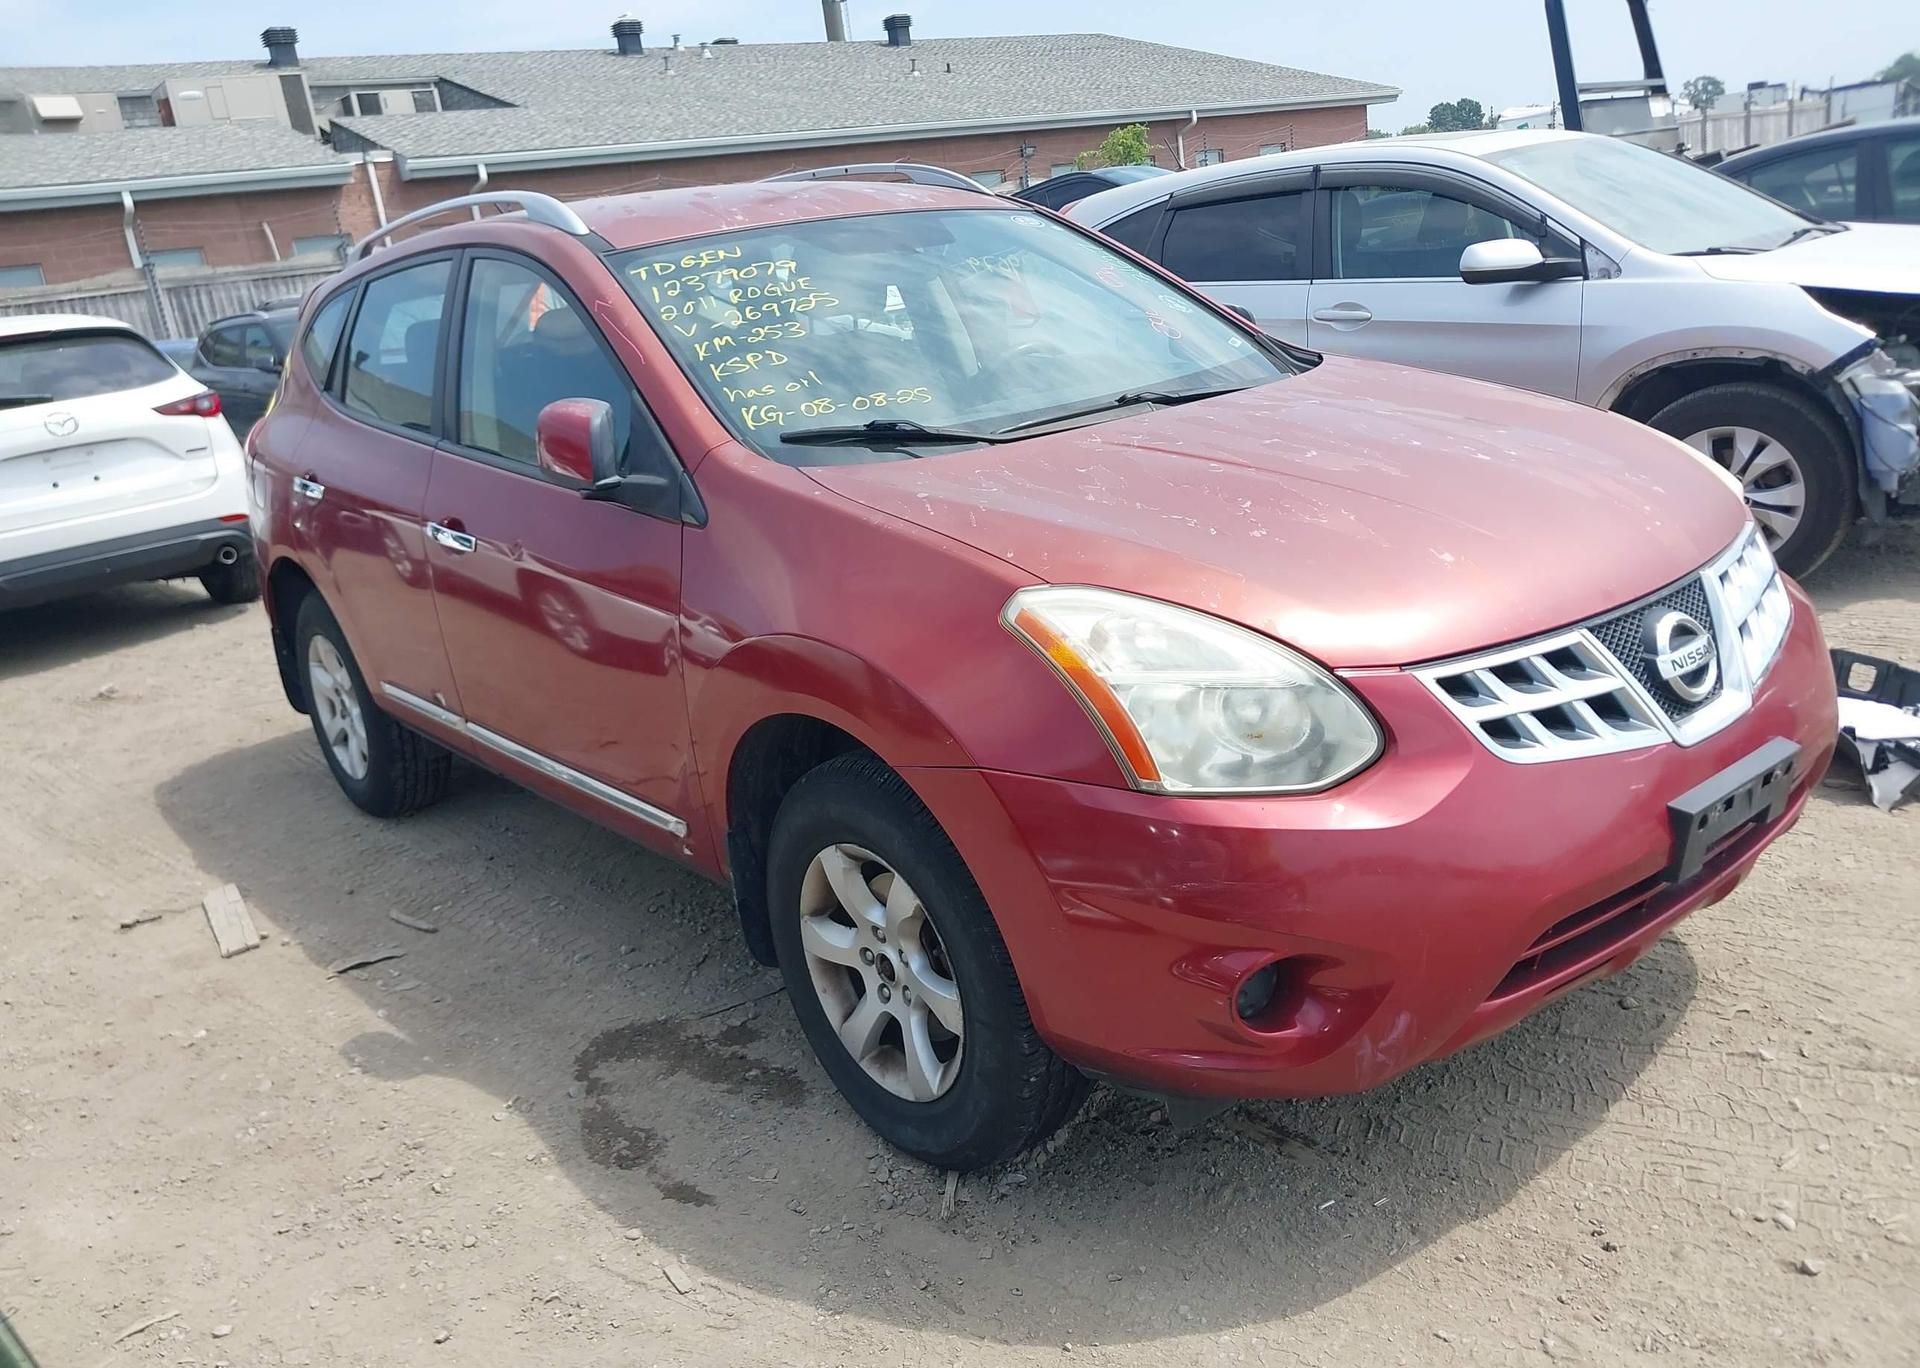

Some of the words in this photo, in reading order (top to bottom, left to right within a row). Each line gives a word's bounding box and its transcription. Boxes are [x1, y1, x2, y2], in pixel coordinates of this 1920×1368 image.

[652, 260, 797, 303] 12379079
[729, 277, 817, 304] ROGUE
[709, 350, 788, 382] KSPD
[1671, 643, 1714, 672] NISSA
